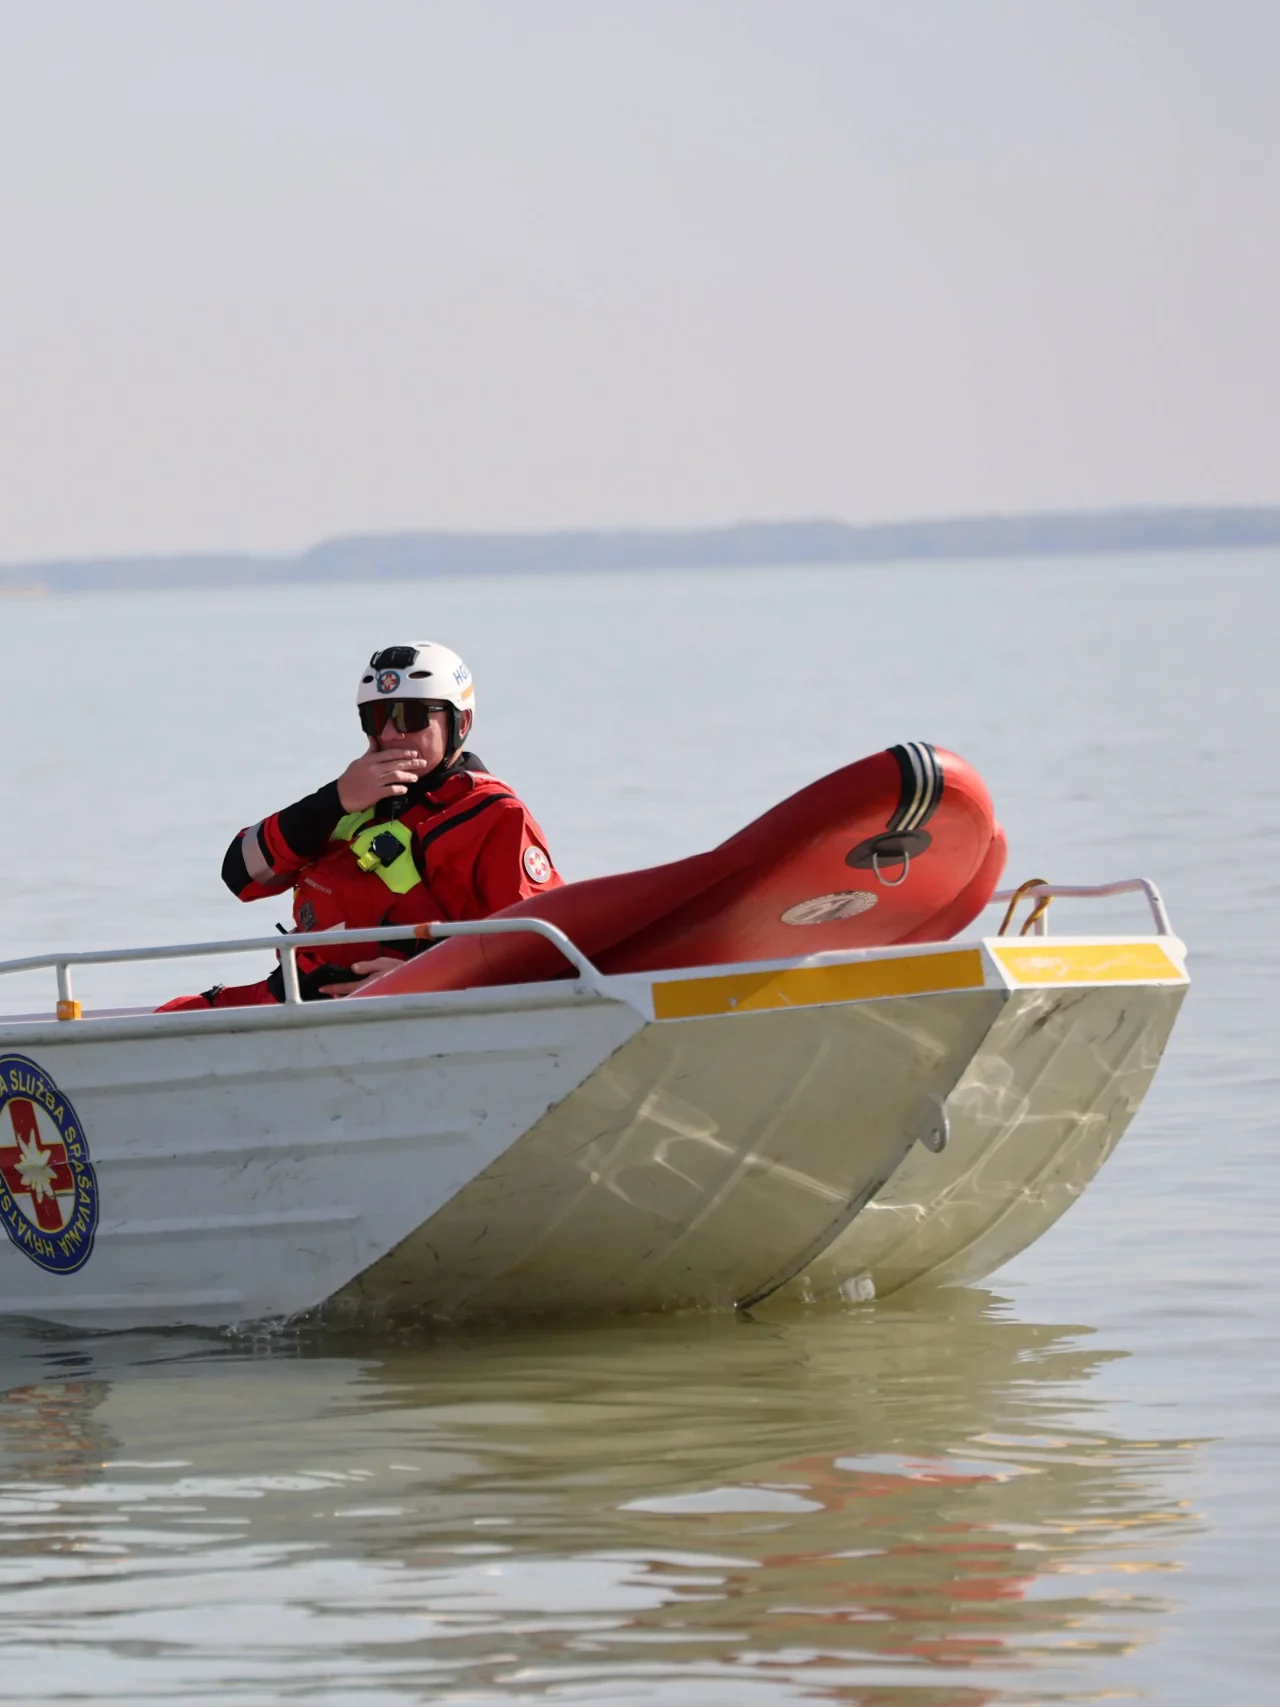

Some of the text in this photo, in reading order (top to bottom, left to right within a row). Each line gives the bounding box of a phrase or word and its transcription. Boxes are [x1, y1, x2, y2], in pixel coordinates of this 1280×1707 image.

[453, 664, 471, 686] HG
[9, 1069, 65, 1125] SLUŽBA
[58, 1126, 94, 1258] SPAŠAVANJA
